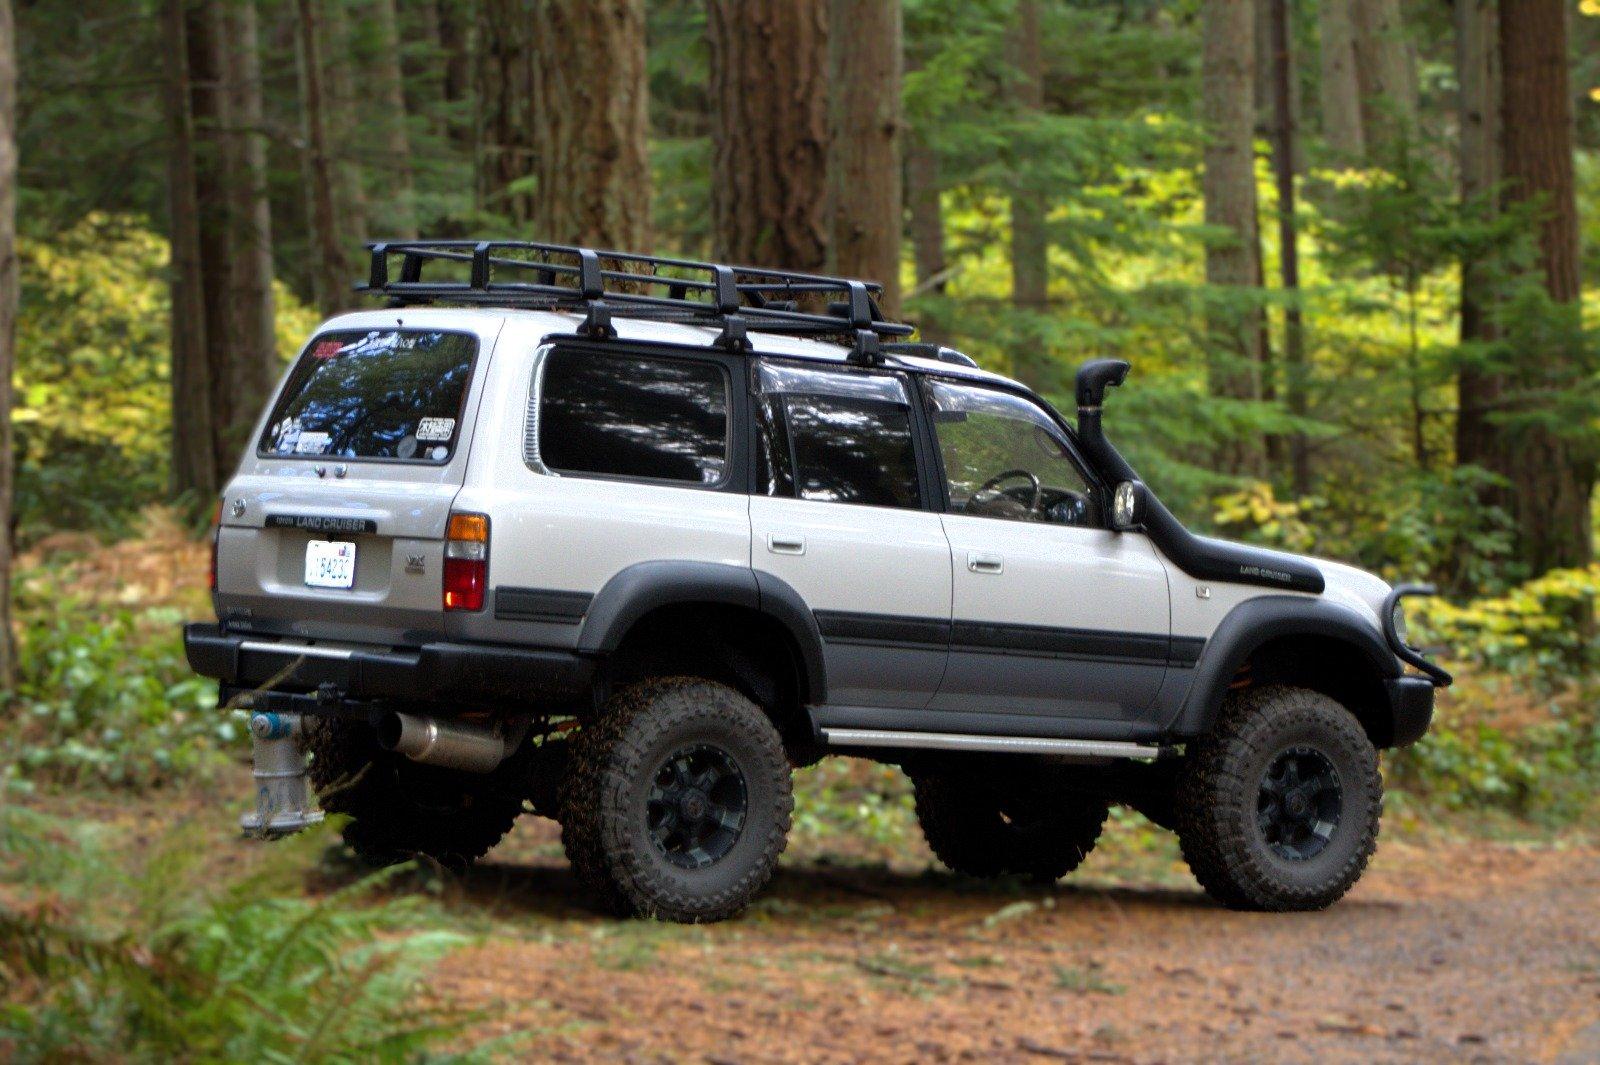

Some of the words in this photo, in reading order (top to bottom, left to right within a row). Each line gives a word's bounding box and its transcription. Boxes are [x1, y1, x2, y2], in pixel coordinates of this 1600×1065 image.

[296, 515, 320, 529] LAND
[323, 518, 366, 532] CRUISER
[1240, 565, 1260, 576] LAND
